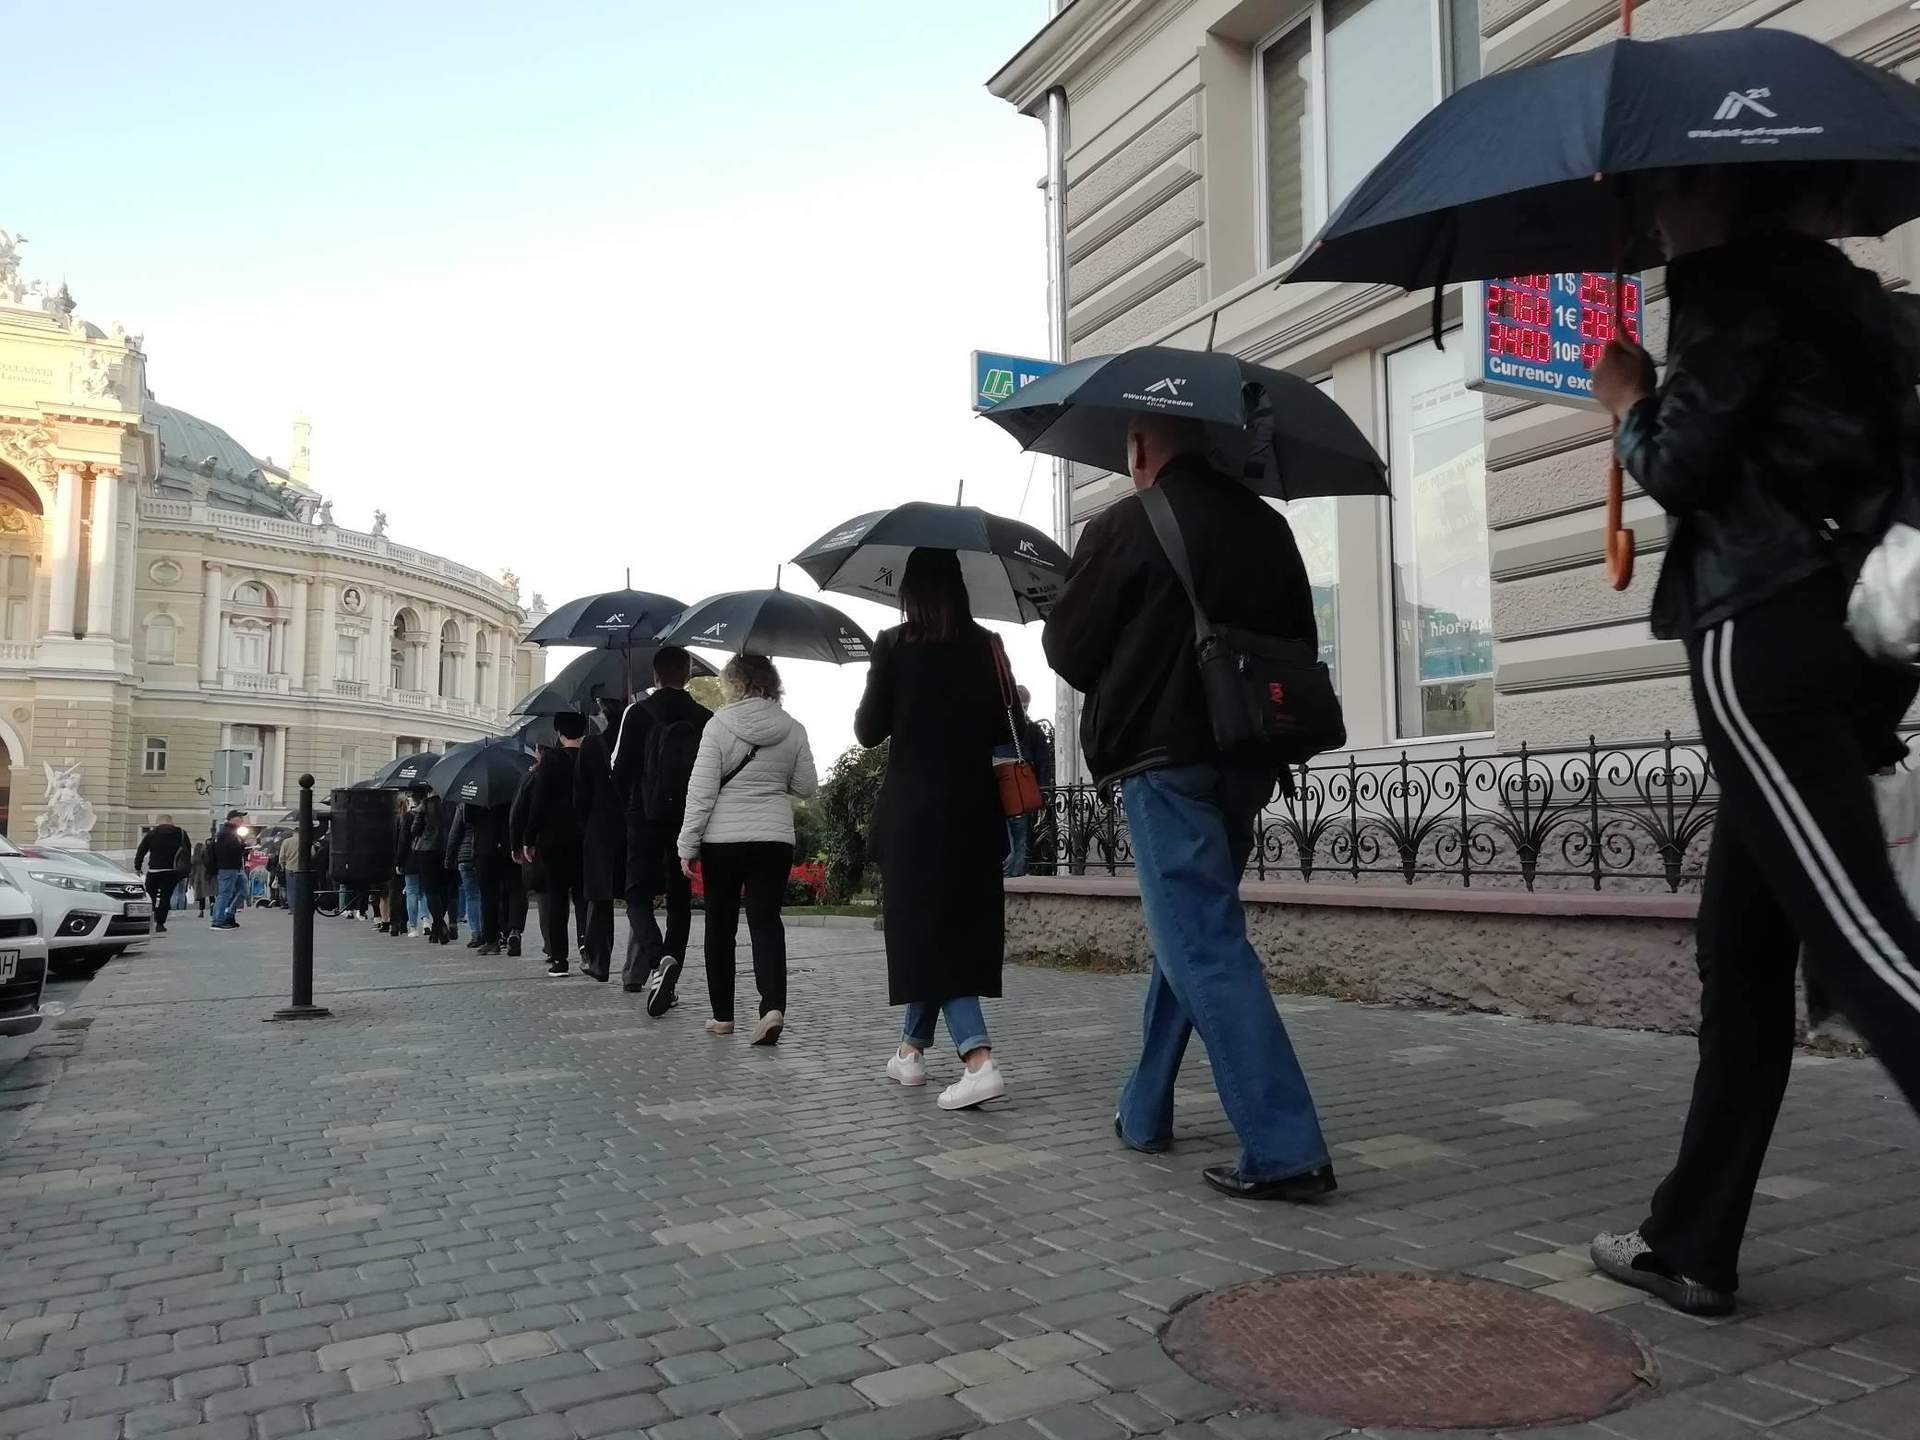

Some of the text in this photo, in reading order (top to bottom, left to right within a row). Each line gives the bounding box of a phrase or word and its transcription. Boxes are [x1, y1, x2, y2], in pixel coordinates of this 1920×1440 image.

[1580, 272, 1638, 313] 25.0
[1555, 305, 1577, 329] 1€
[1489, 357, 1594, 391] Currency exc
